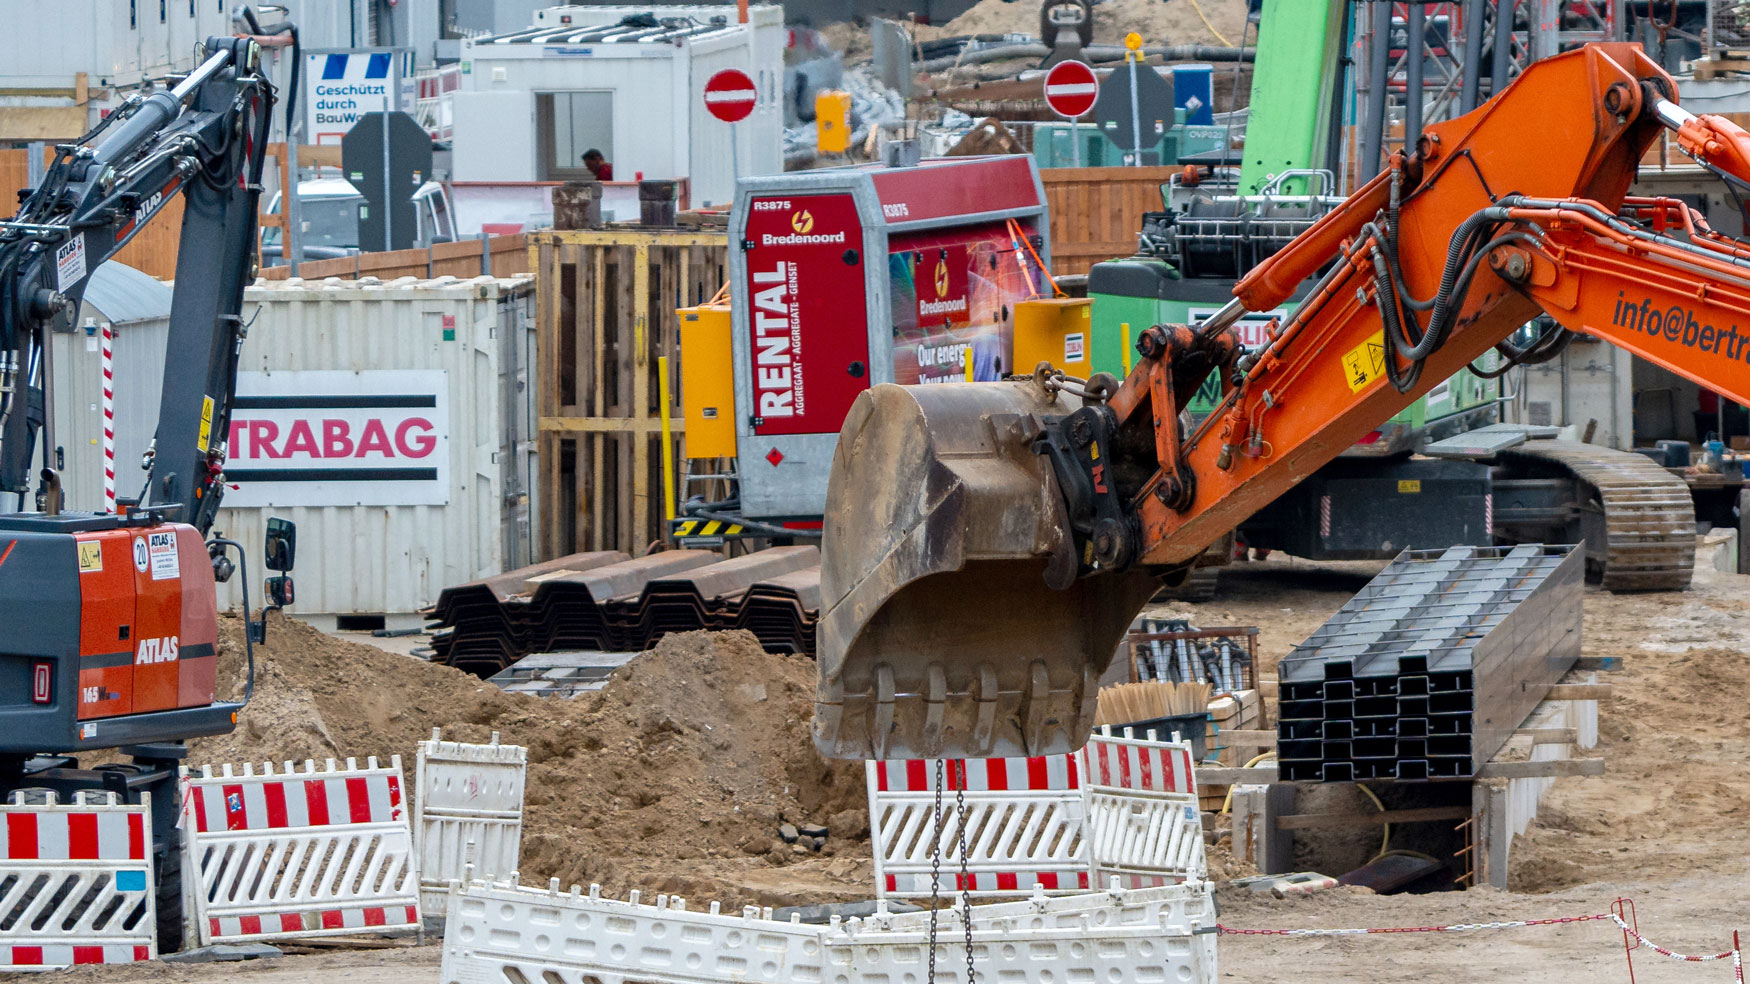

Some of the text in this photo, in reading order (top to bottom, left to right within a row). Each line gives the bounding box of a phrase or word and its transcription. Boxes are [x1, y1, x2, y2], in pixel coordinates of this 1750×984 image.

[316, 84, 386, 96] Geschützt
[316, 98, 357, 110] durch
[135, 192, 162, 225] ATLAS
[753, 201, 791, 210] R3875
[883, 203, 909, 217] R3875
[762, 231, 845, 246] Bredenoord
[919, 295, 967, 315] Bredenoord
[753, 261, 794, 417] RENTAL
[788, 261, 806, 416] AGGREGAAT AGGREGATE GENSET
[917, 343, 935, 367] Our
[228, 417, 437, 459] TRABAG
[151, 534, 169, 547] ATLAS
[136, 543, 147, 566] 20
[136, 636, 178, 665] ATLAS
